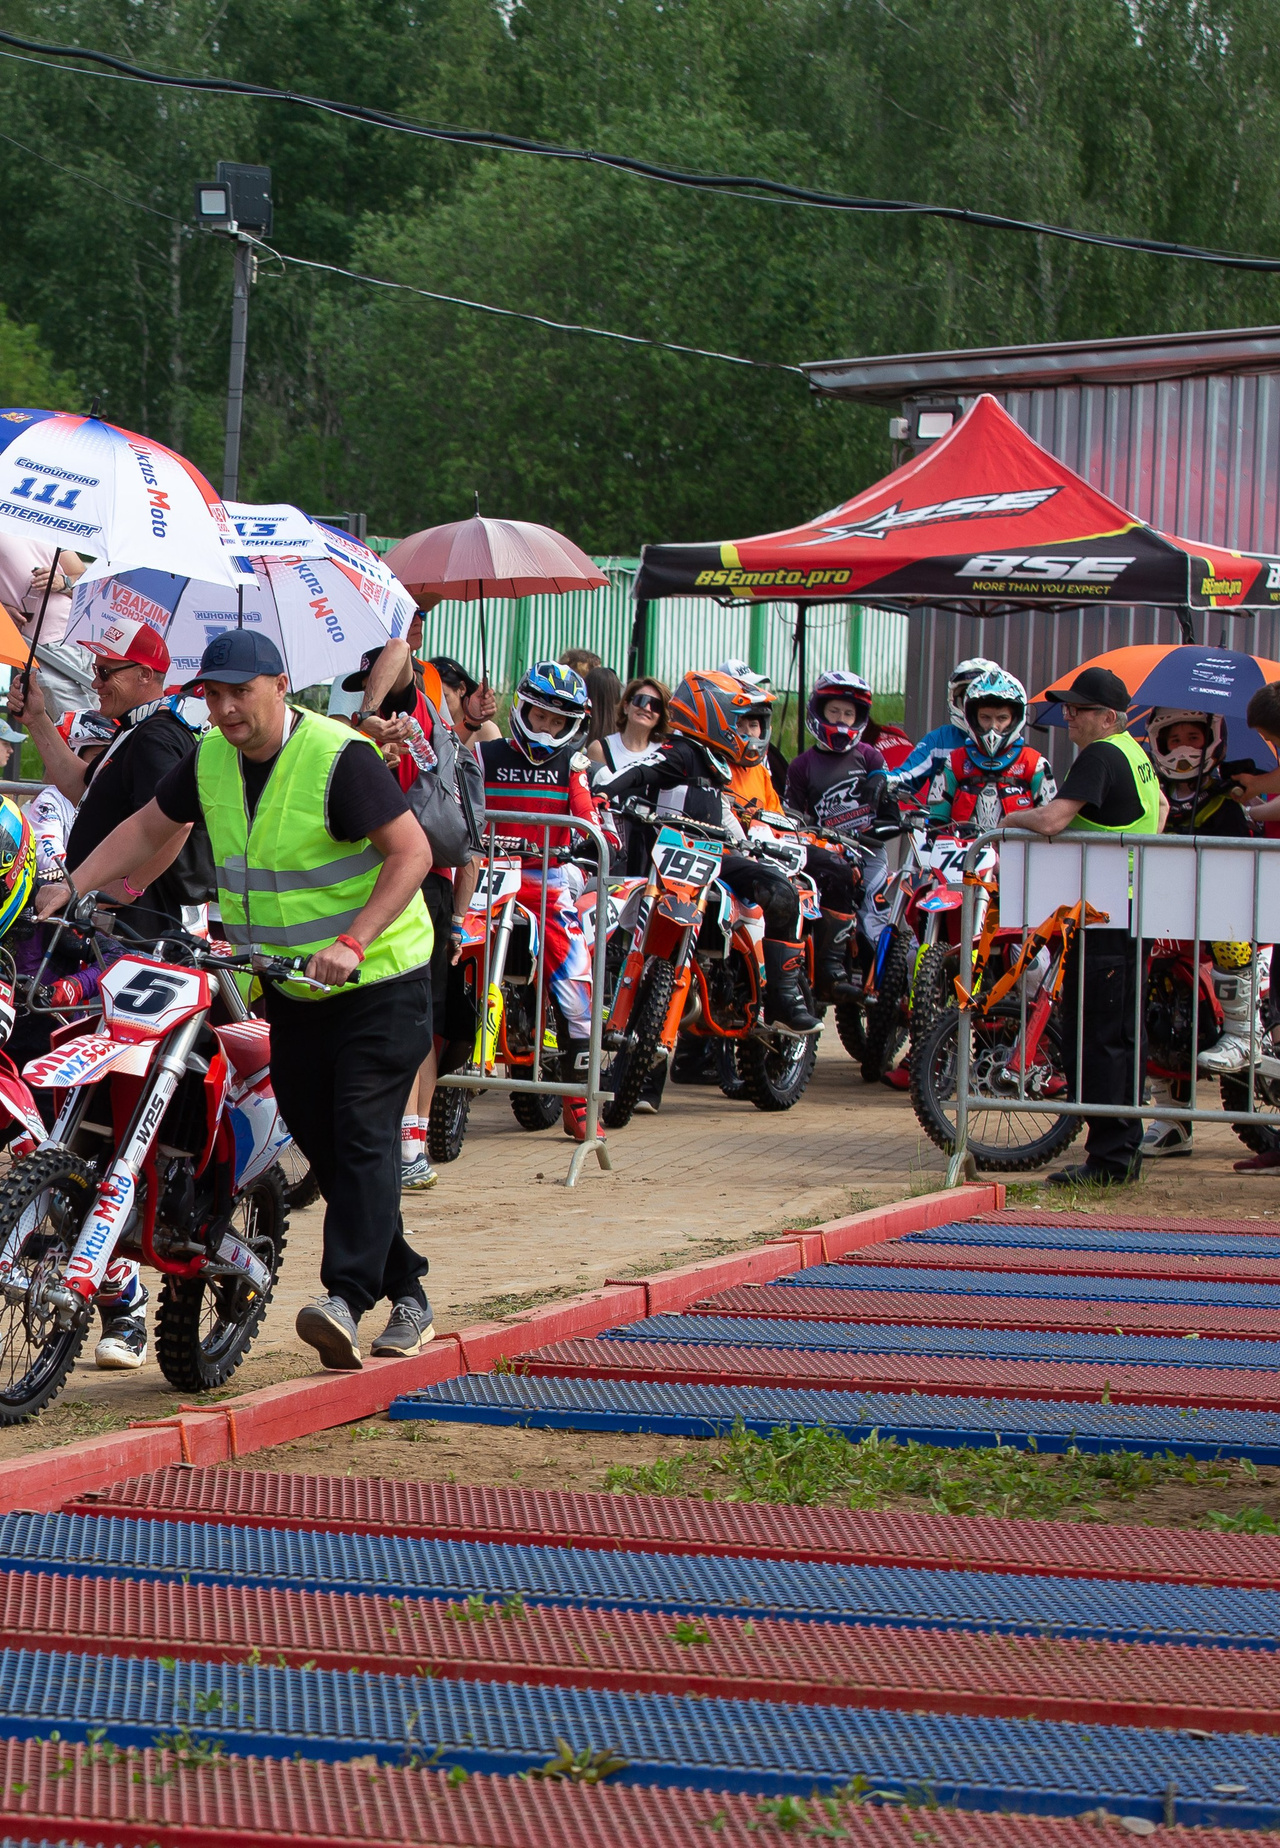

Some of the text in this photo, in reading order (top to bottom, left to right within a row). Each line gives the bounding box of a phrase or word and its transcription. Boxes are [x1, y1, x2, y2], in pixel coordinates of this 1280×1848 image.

[11, 477, 82, 511] 111
[146, 488, 171, 538] Moto
[694, 569, 851, 588] BSEmoto.pro
[955, 555, 1136, 582] BSE
[973, 581, 1111, 595] MORE THAN YOU EXPECT
[497, 767, 559, 784] SEVEN
[658, 848, 717, 886] 193
[113, 968, 190, 1016] 5
[136, 1093, 165, 1145] WPS
[69, 1174, 132, 1273] Moto Uktus
